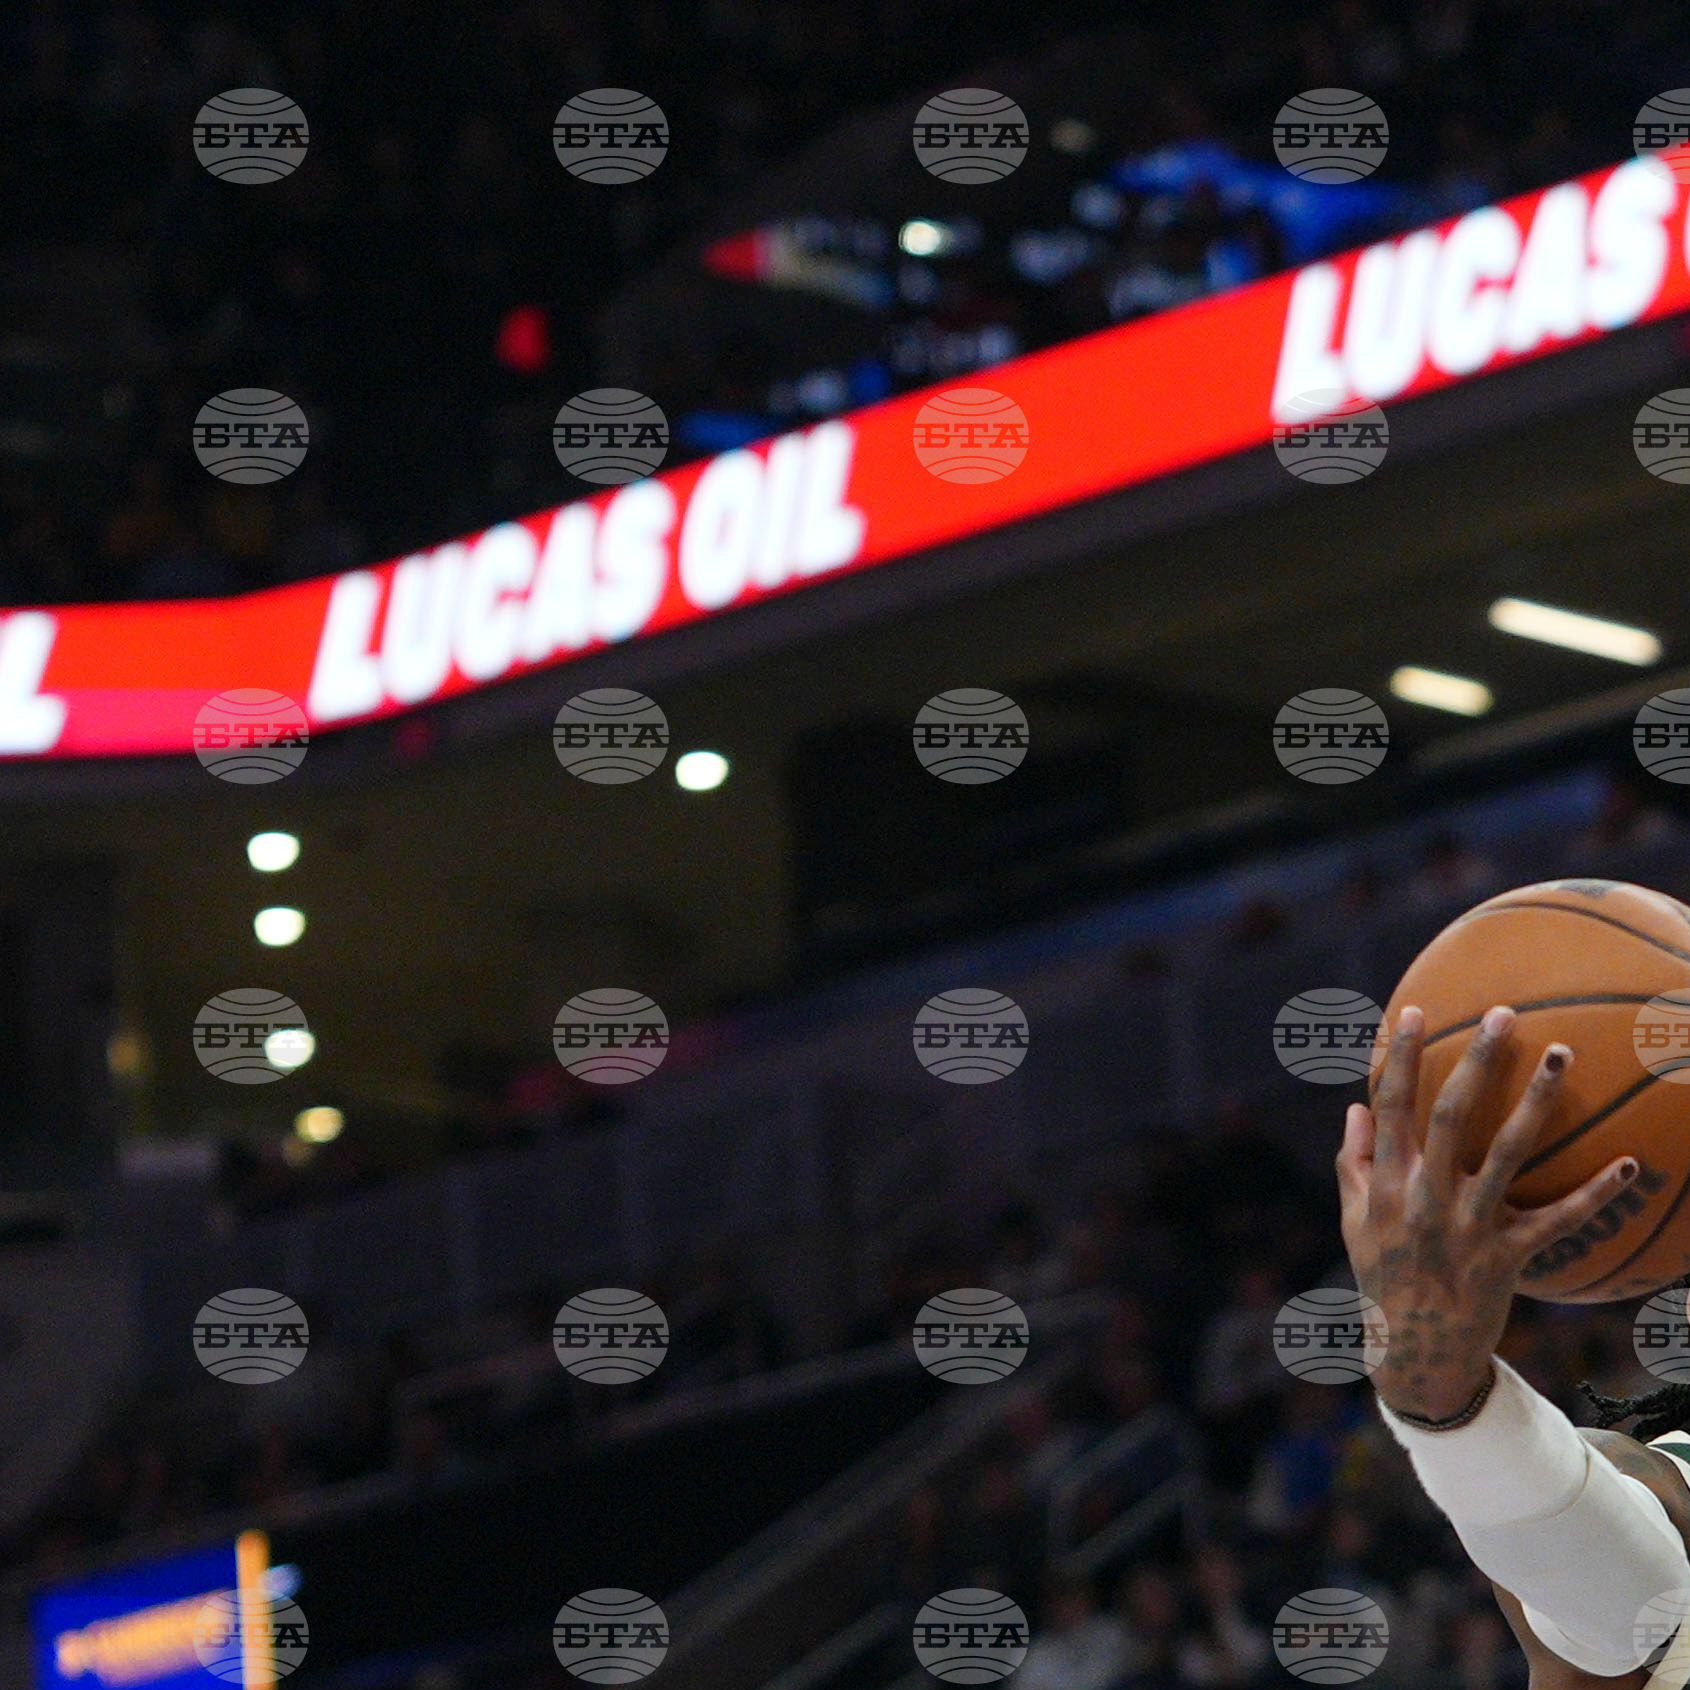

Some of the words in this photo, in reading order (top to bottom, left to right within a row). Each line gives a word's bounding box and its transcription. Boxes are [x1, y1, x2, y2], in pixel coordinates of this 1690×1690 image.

[1271, 153, 1678, 426] LUCAS
[307, 475, 677, 724] LUCAS
[678, 418, 866, 611] OIL
